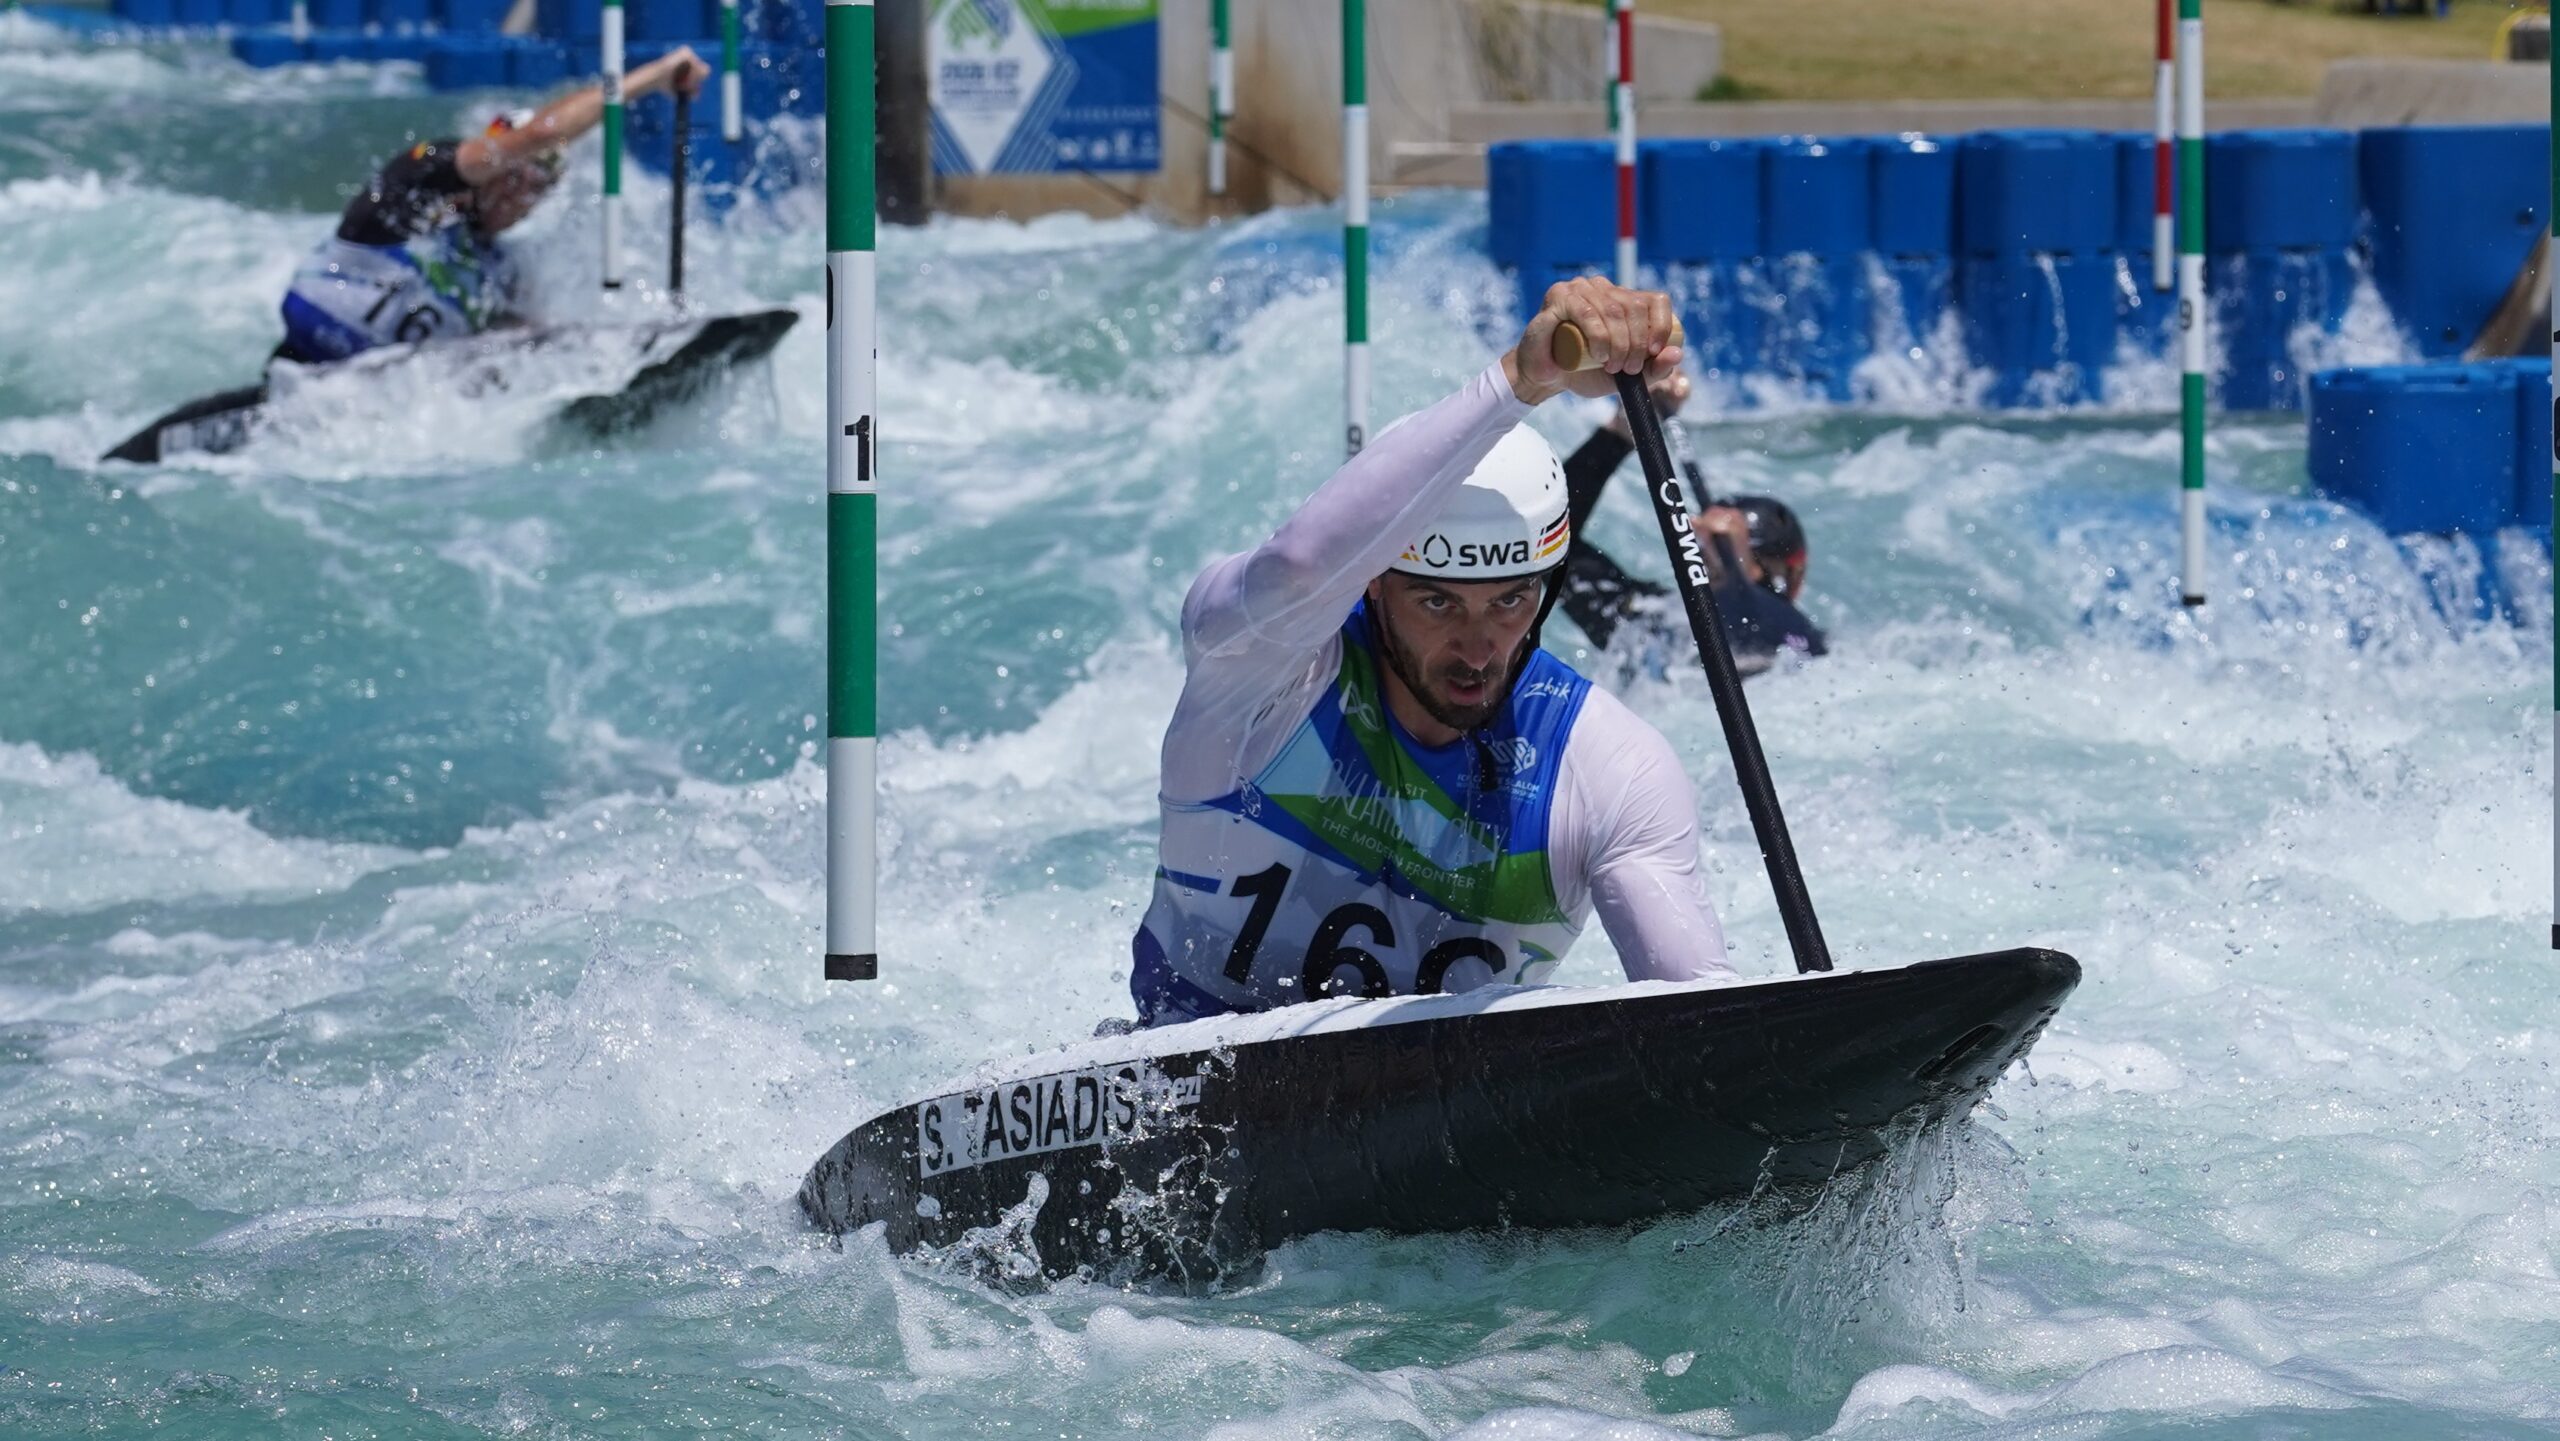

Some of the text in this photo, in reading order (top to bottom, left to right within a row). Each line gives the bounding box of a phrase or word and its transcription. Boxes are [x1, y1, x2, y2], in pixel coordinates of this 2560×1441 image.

[1458, 539, 1529, 567] swa
[1671, 512, 1710, 587] swa
[1320, 815, 1477, 890] THE MODERN FRONTIER
[924, 1103, 953, 1171] S.
